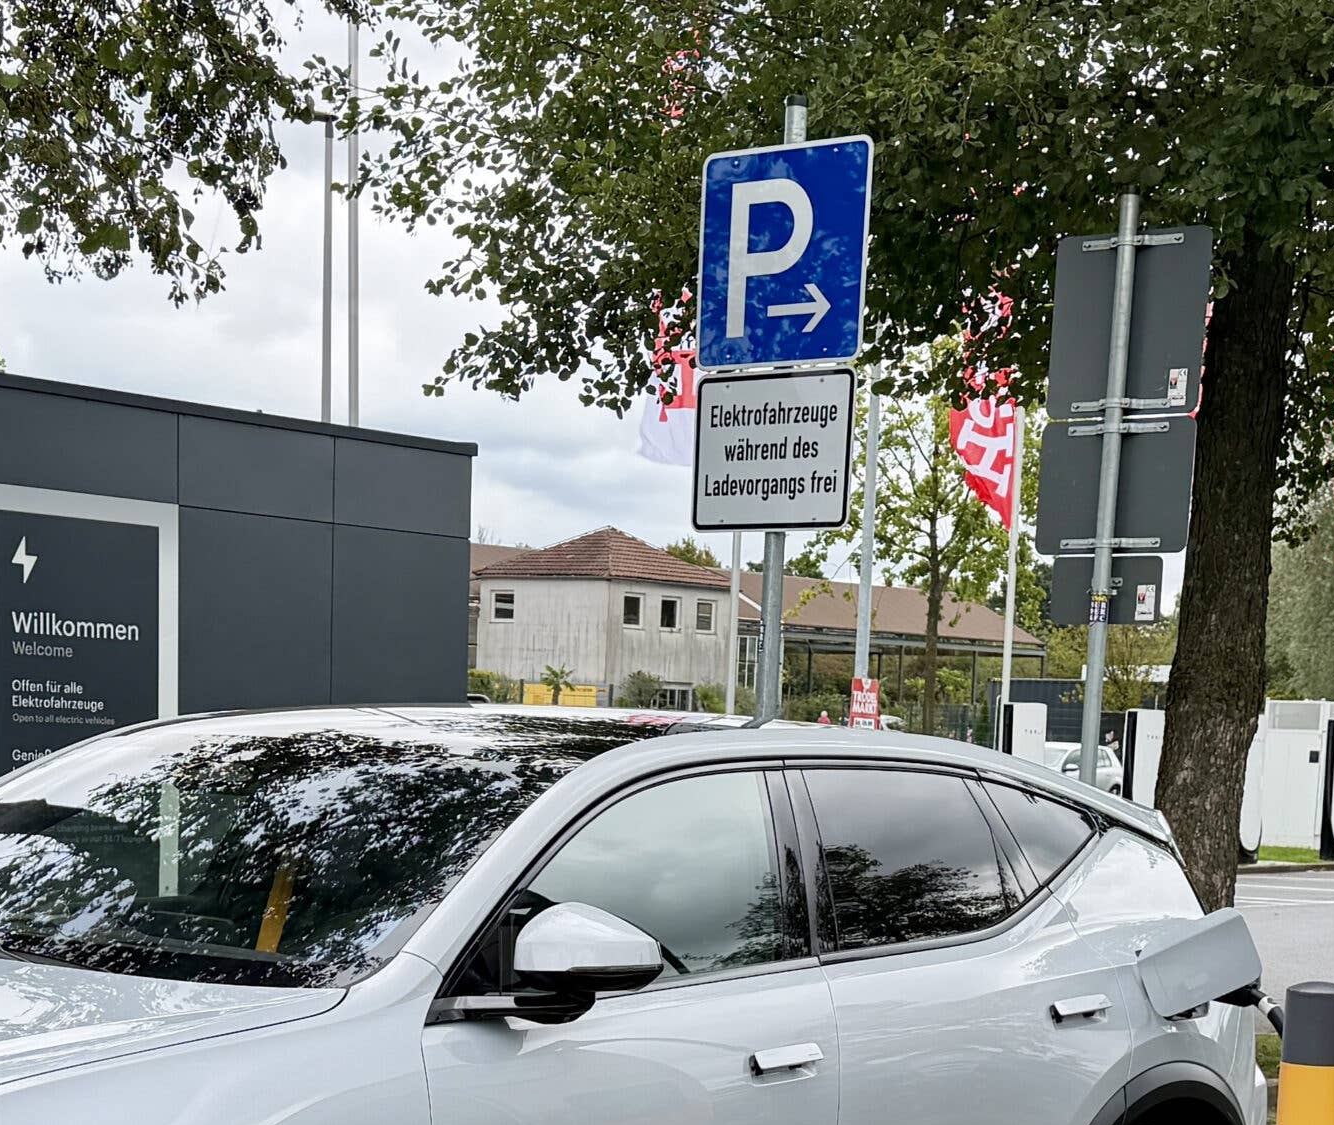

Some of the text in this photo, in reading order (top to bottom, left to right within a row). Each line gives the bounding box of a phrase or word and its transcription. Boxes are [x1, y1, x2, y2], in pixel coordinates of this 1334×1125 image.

[726, 178, 814, 338] P
[710, 401, 838, 429] Elektrofahrzeuge
[724, 435, 819, 462] während des
[704, 469, 837, 501] Ladevorgangs frei
[11, 611, 139, 641] Willkommen
[12, 641, 74, 658] Welcome
[11, 679, 83, 694] Offen für alle
[11, 695, 105, 713] Elektrofahrzeuge
[12, 713, 115, 725] Open to all electric vehicles
